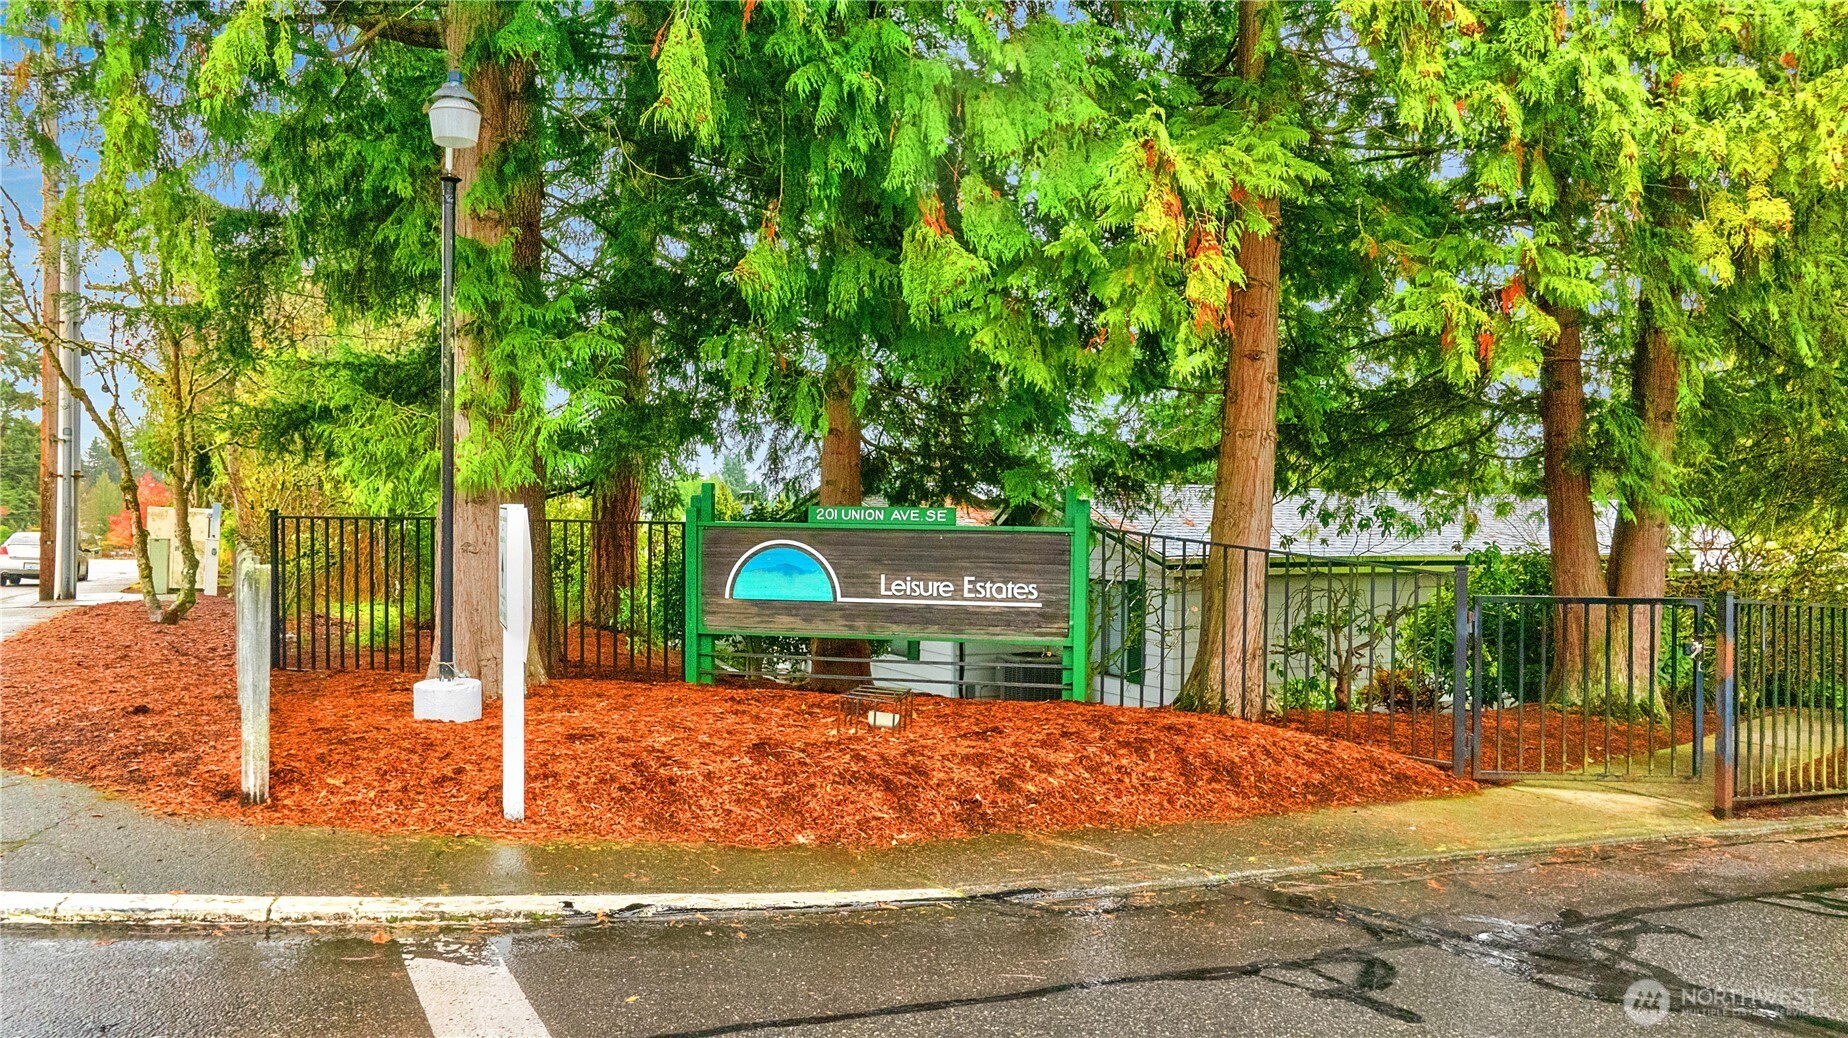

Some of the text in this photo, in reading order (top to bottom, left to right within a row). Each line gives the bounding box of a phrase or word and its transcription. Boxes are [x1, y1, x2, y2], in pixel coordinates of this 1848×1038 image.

[816, 508, 838, 520] 201
[841, 509, 884, 521] UNION
[926, 510, 947, 522] SE
[880, 574, 1039, 600] Leisure Estates
